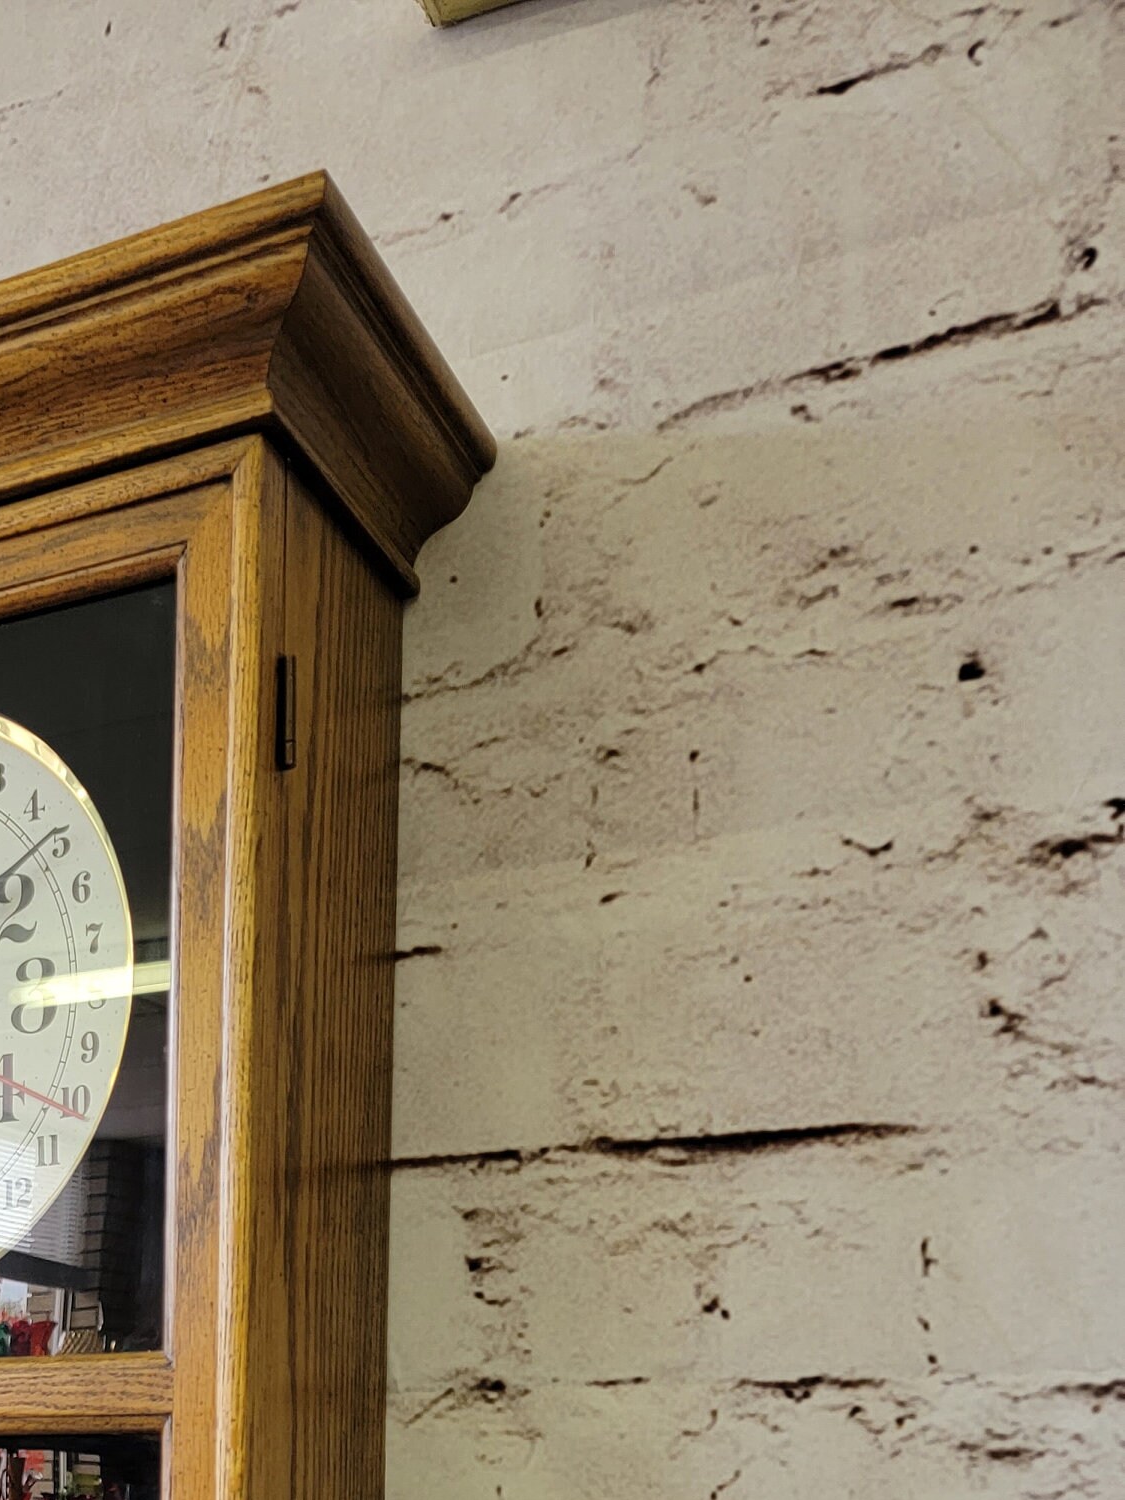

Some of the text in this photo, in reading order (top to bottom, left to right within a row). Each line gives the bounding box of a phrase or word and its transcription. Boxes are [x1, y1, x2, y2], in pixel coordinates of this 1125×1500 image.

[23, 789, 45, 822] 4
[52, 824, 71, 858] 5
[72, 871, 91, 903] 6
[85, 922, 103, 954] 7
[81, 1031, 99, 1063] 9
[60, 1085, 91, 1120] 10
[35, 1135, 60, 1167] 11
[3, 1178, 32, 1210] 12
